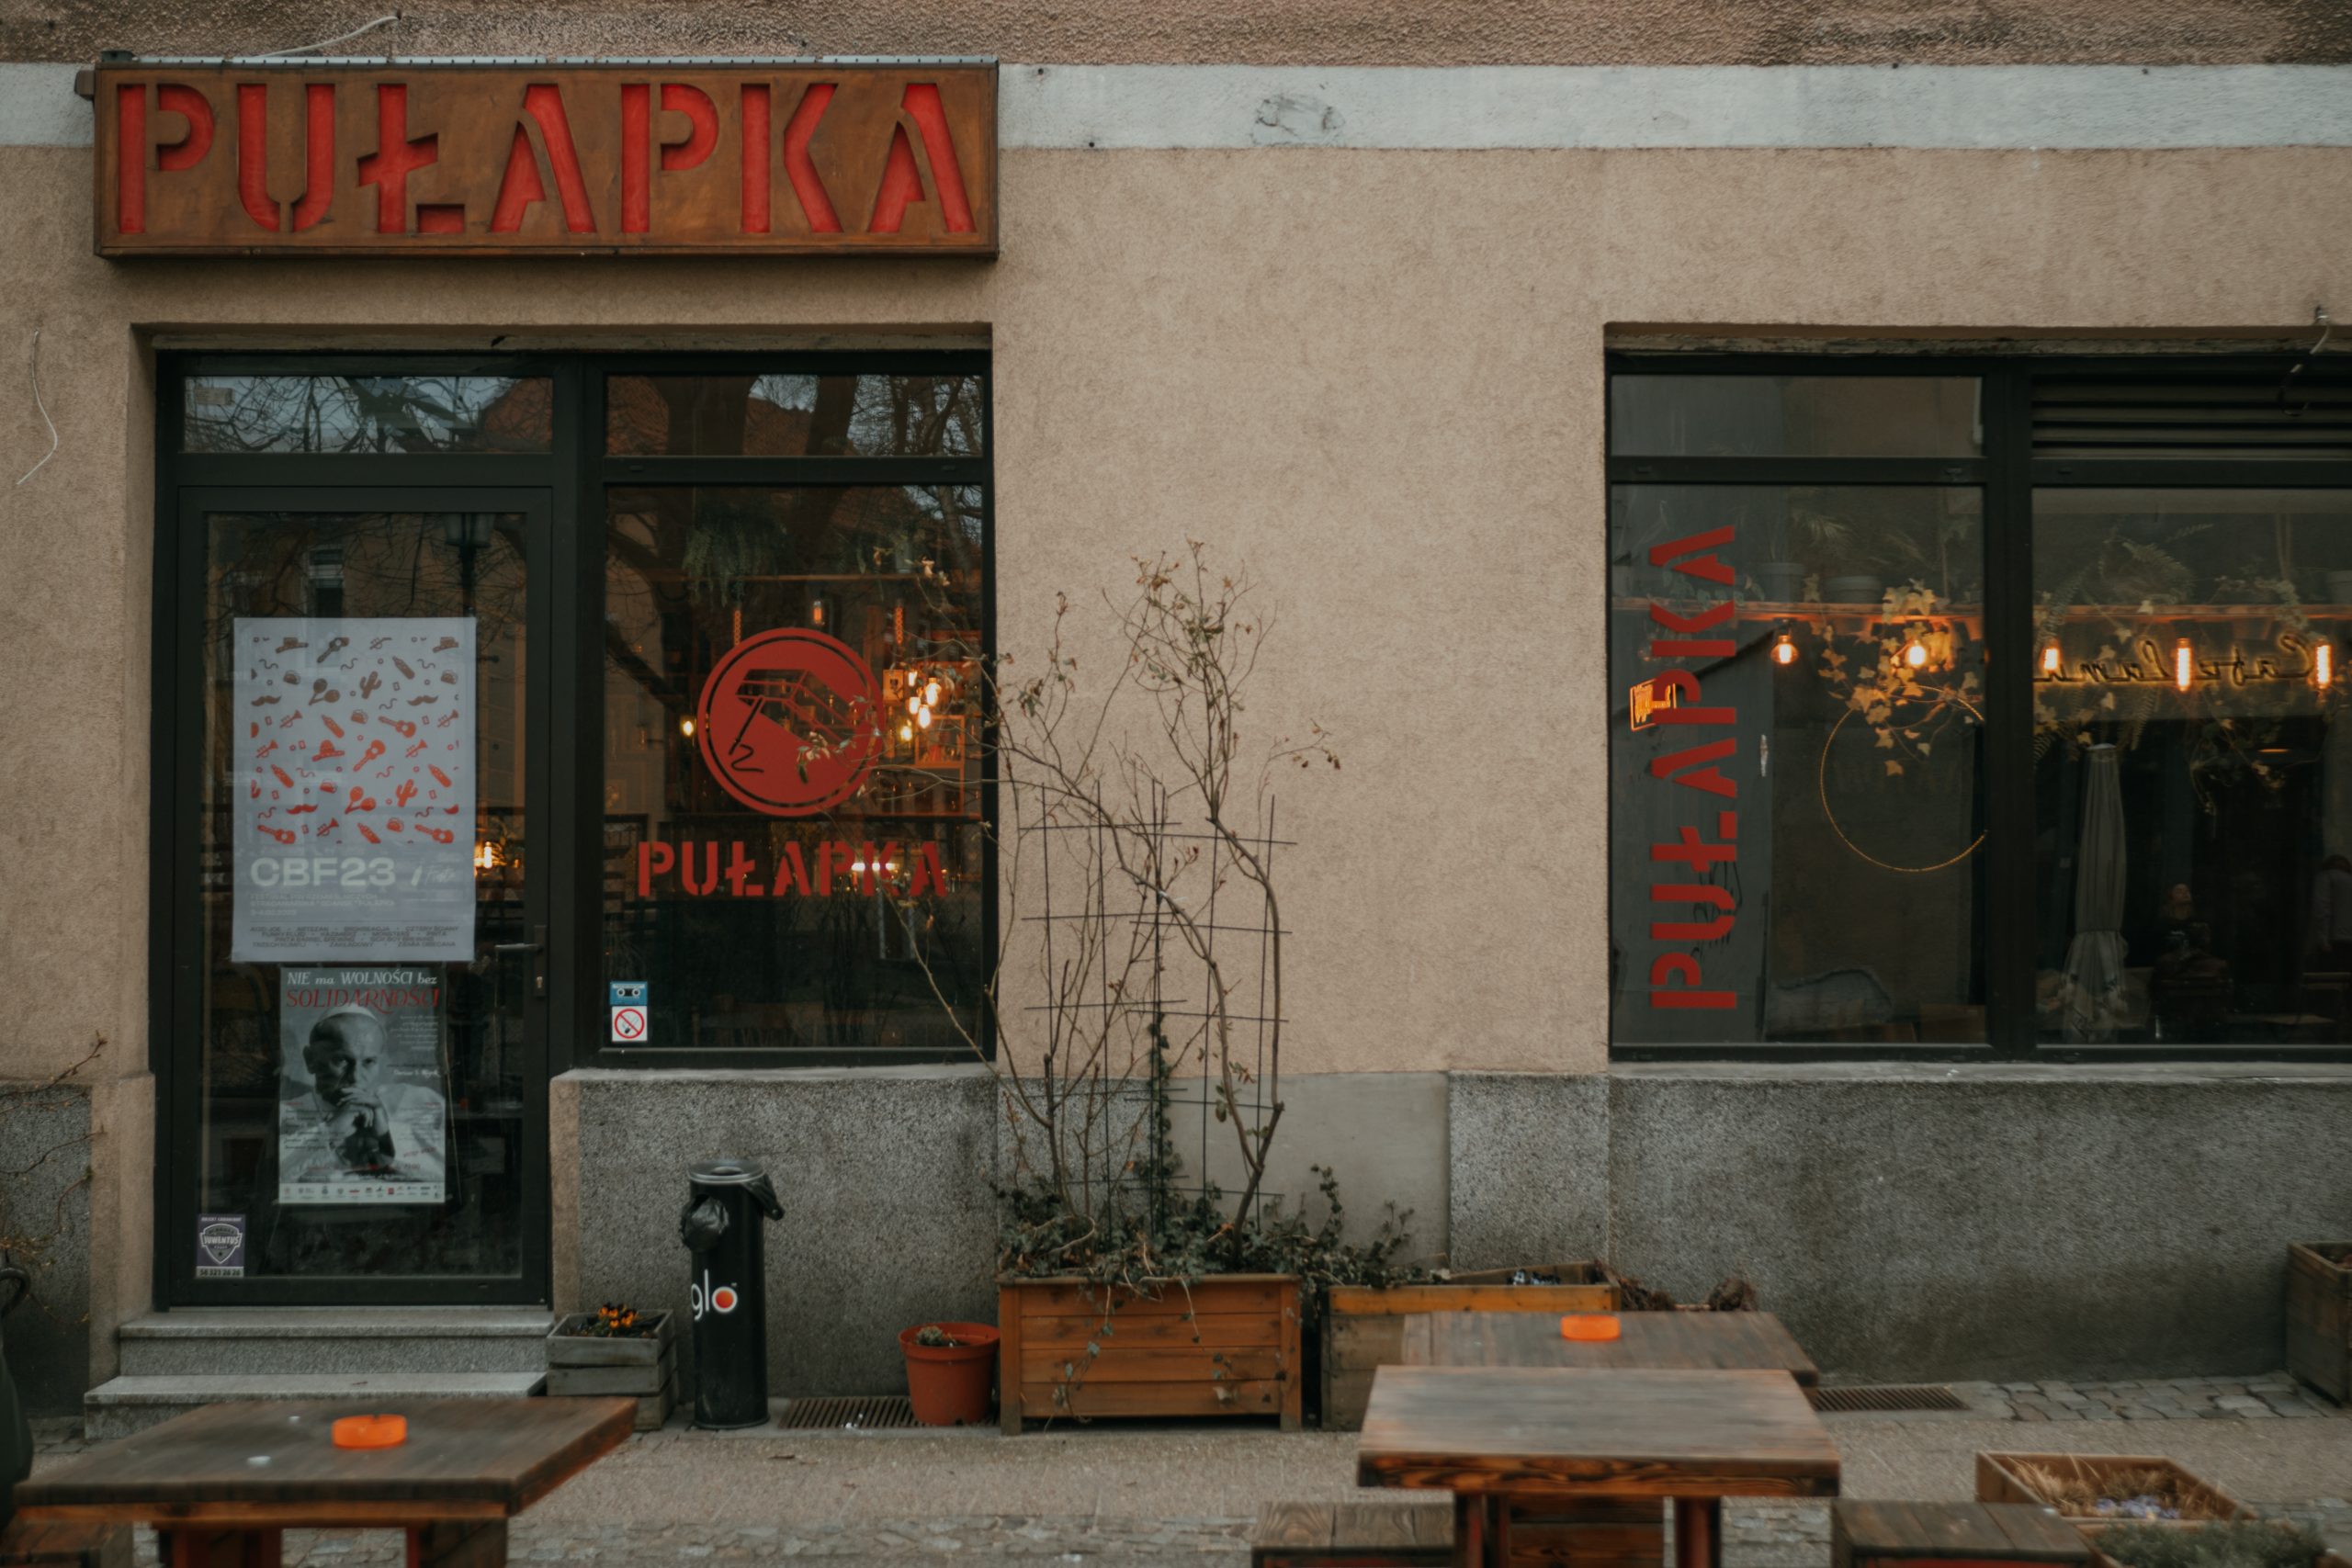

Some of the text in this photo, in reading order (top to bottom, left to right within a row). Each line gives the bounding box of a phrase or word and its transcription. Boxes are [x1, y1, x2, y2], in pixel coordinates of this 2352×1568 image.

[116, 83, 977, 233] PUŁAPKA
[1650, 525, 1737, 1008] PUŁAPKA
[251, 857, 396, 887] CBF23
[639, 841, 948, 897] PUŁAPKA
[286, 986, 440, 1014] SOLIDARNOŚCI
[287, 969, 438, 986] NIE ma WOLNOŚCI bez
[691, 1269, 738, 1321] glo
